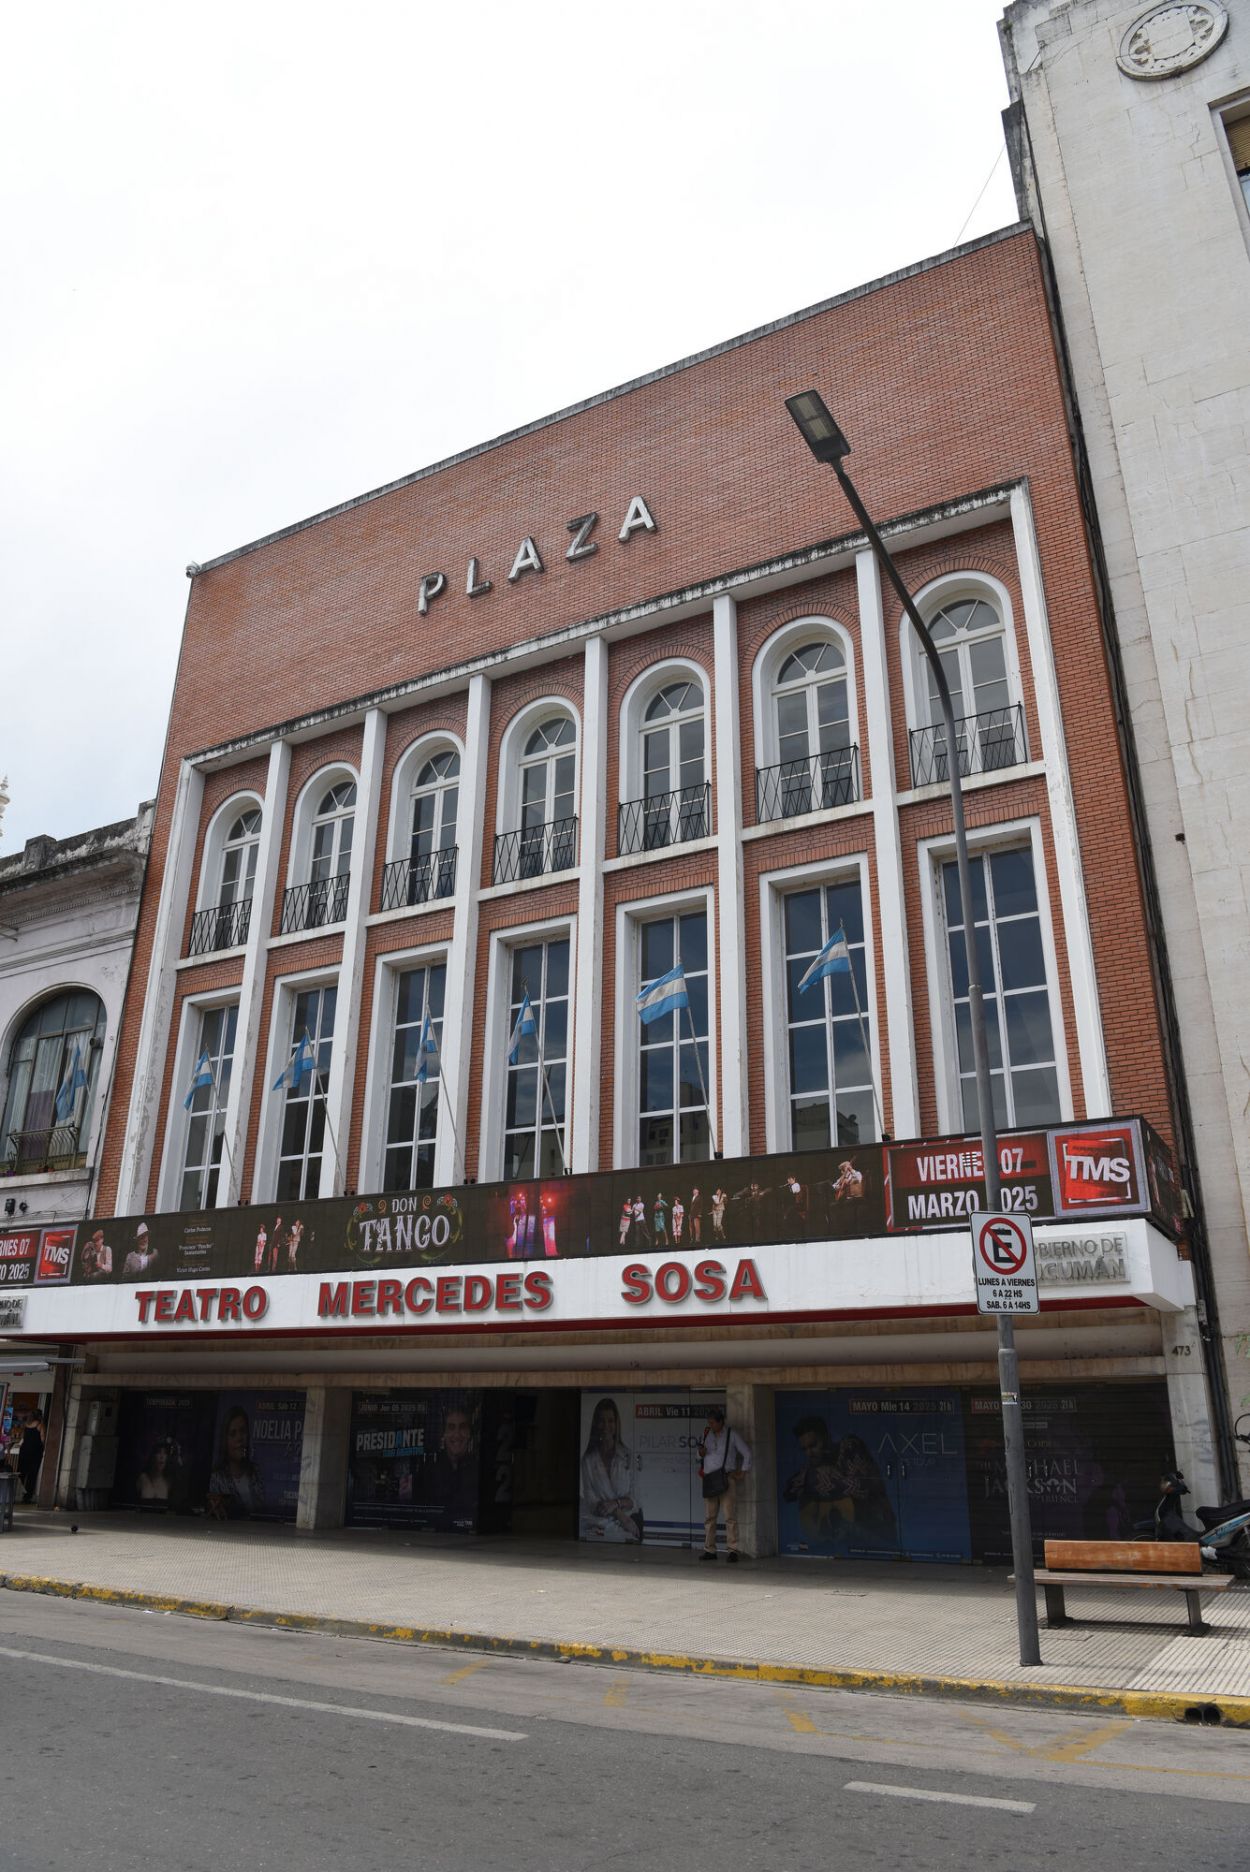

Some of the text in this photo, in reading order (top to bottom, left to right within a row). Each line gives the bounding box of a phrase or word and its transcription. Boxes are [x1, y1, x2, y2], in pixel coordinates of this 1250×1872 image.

[418, 495, 657, 616] PLAZA
[916, 1148, 1023, 1181] VIERNE 07
[1064, 1155, 1130, 1182] TMS
[392, 1197, 417, 1213] DON
[907, 1186, 1038, 1220] MARZO 025
[359, 1215, 450, 1251] TANGO
[0, 1239, 30, 1257] RNES 07
[44, 1245, 69, 1264] TMS
[1035, 1237, 1123, 1259] BIERNO DE
[8, 1264, 30, 1280] 2025
[1037, 1256, 1126, 1281] CUMÁN
[135, 1259, 768, 1324] TEATRO MERCEDES SOSA
[978, 1278, 1036, 1287] LUNES A VIERNES
[993, 1289, 1023, 1298] 6 A 22 HS
[986, 1300, 1002, 1310] SAB.
[1003, 1301, 1008, 1310] 6
[1008, 1301, 1014, 1310] A
[1171, 1345, 1191, 1357] 473
[638, 1406, 663, 1417] ABRIL
[681, 1406, 690, 1416] 11
[852, 1401, 878, 1411] MAYO
[899, 1401, 910, 1411] 14
[974, 1400, 1000, 1410] MAYO
[253, 1418, 291, 1441] NOELIA
[639, 1433, 677, 1449] PILAR
[878, 1432, 958, 1455] AXEL
